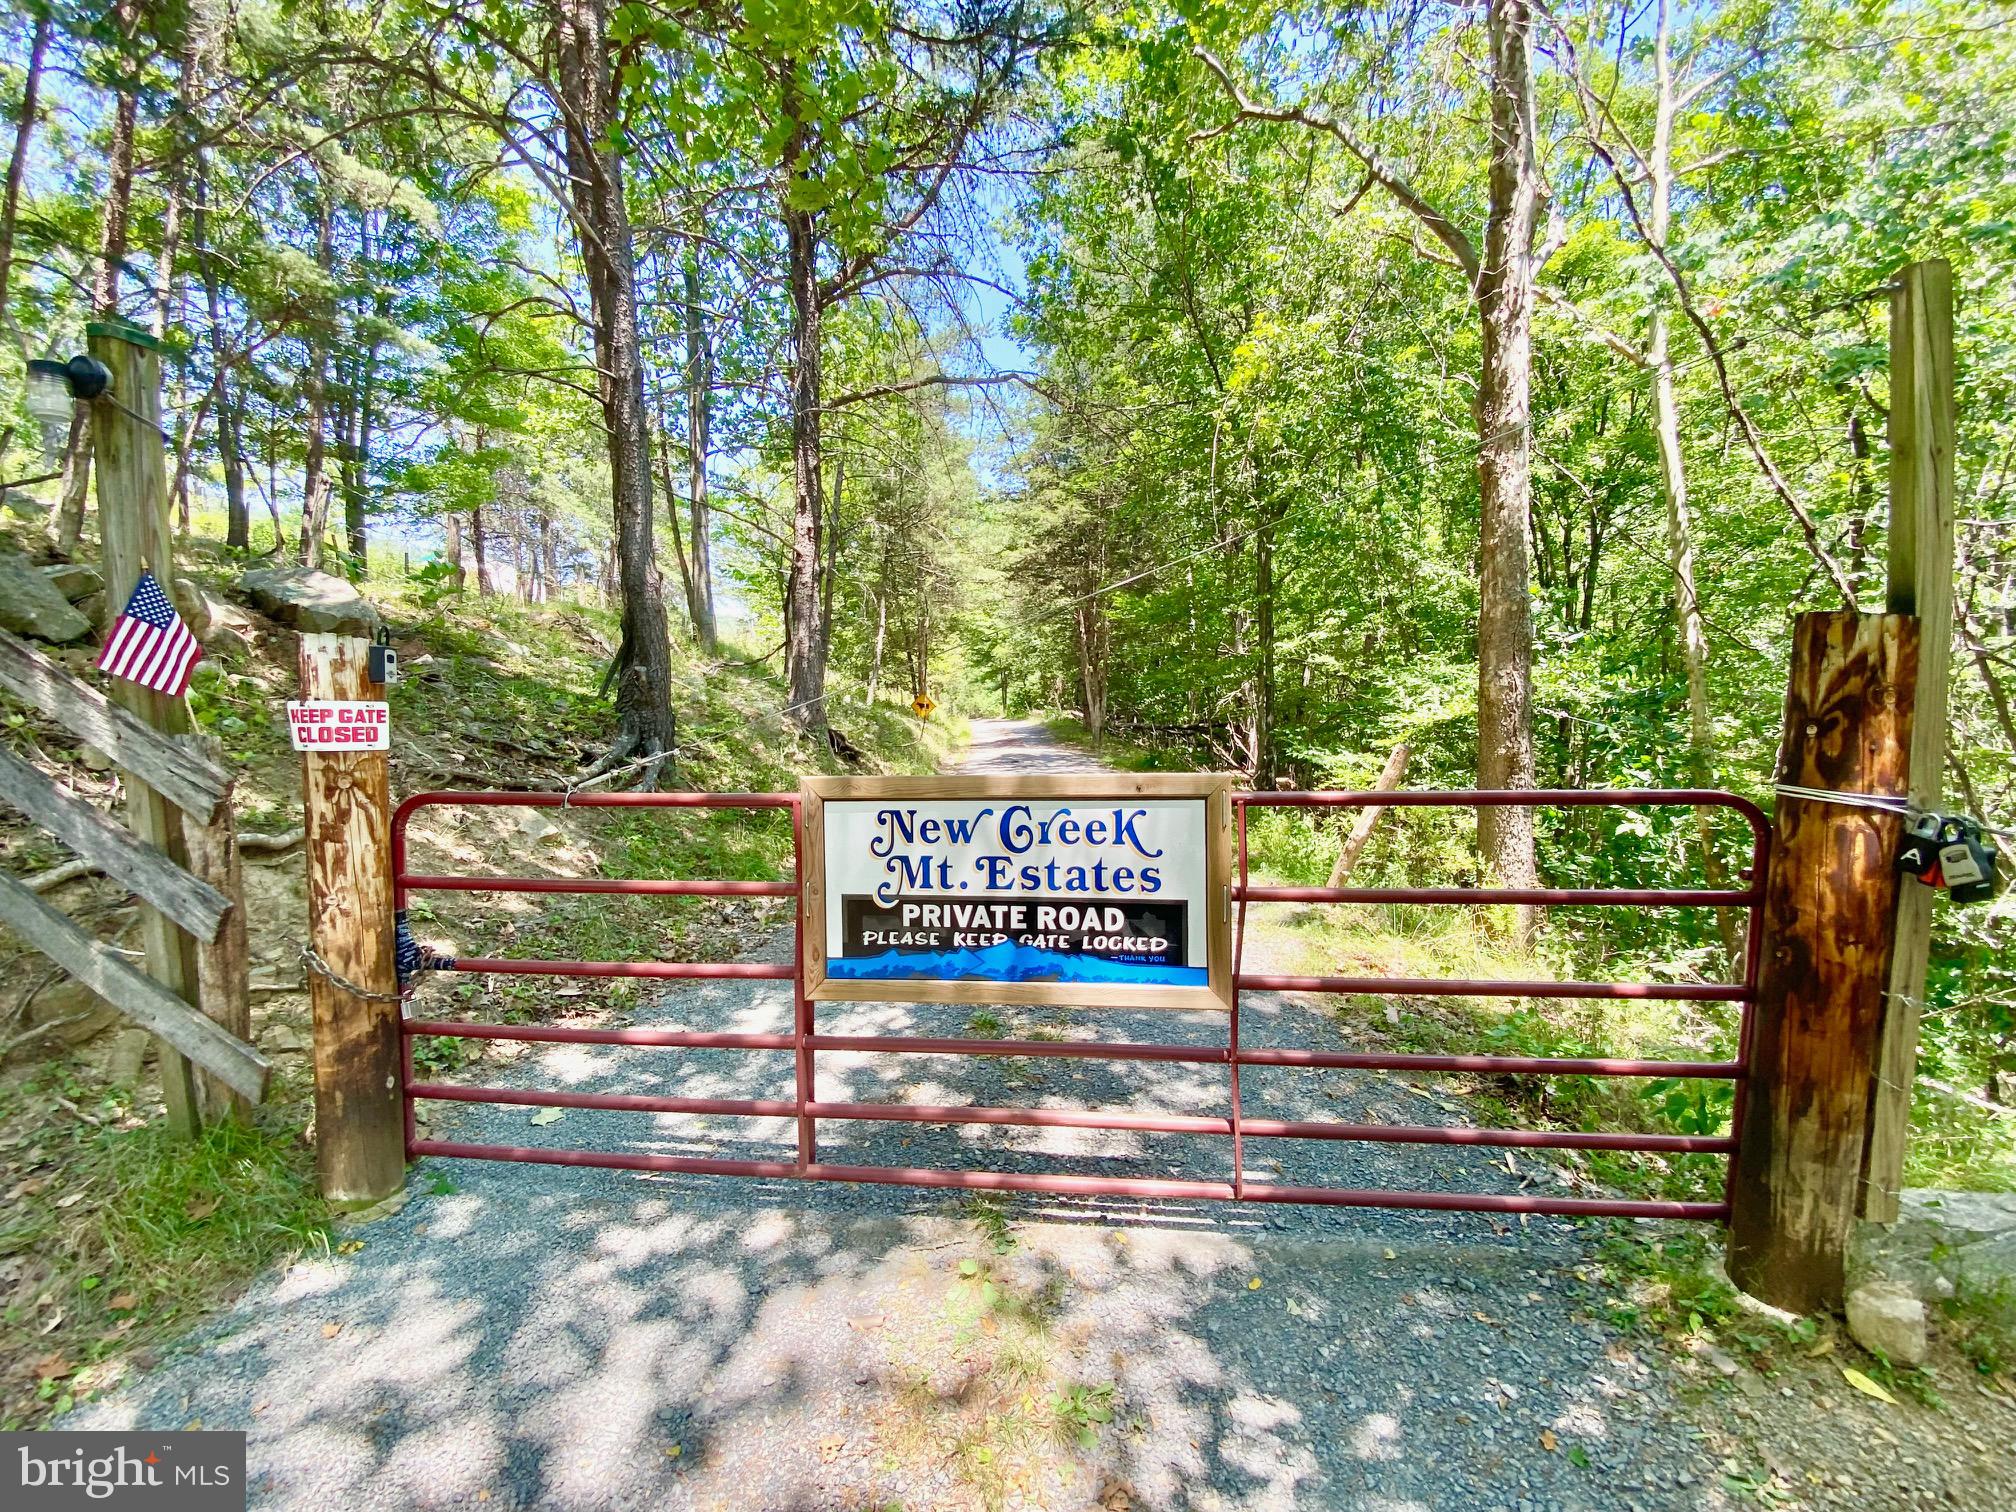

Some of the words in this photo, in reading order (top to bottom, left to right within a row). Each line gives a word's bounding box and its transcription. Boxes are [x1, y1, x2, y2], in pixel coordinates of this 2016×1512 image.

[290, 708, 334, 724] KEEP
[338, 708, 387, 724] GATE
[297, 726, 379, 743] CLOSED
[870, 808, 994, 857] New
[877, 855, 968, 904] Mt.
[975, 855, 1163, 893] Estates
[902, 903, 1027, 929] PRIVATE
[1037, 905, 1125, 932] ROAD
[862, 930, 940, 946] PLEASE
[953, 931, 1009, 947] KEEP
[1018, 933, 1071, 949] GATE
[1082, 935, 1168, 952] LOCKED
[1149, 955, 1166, 963] YOU
